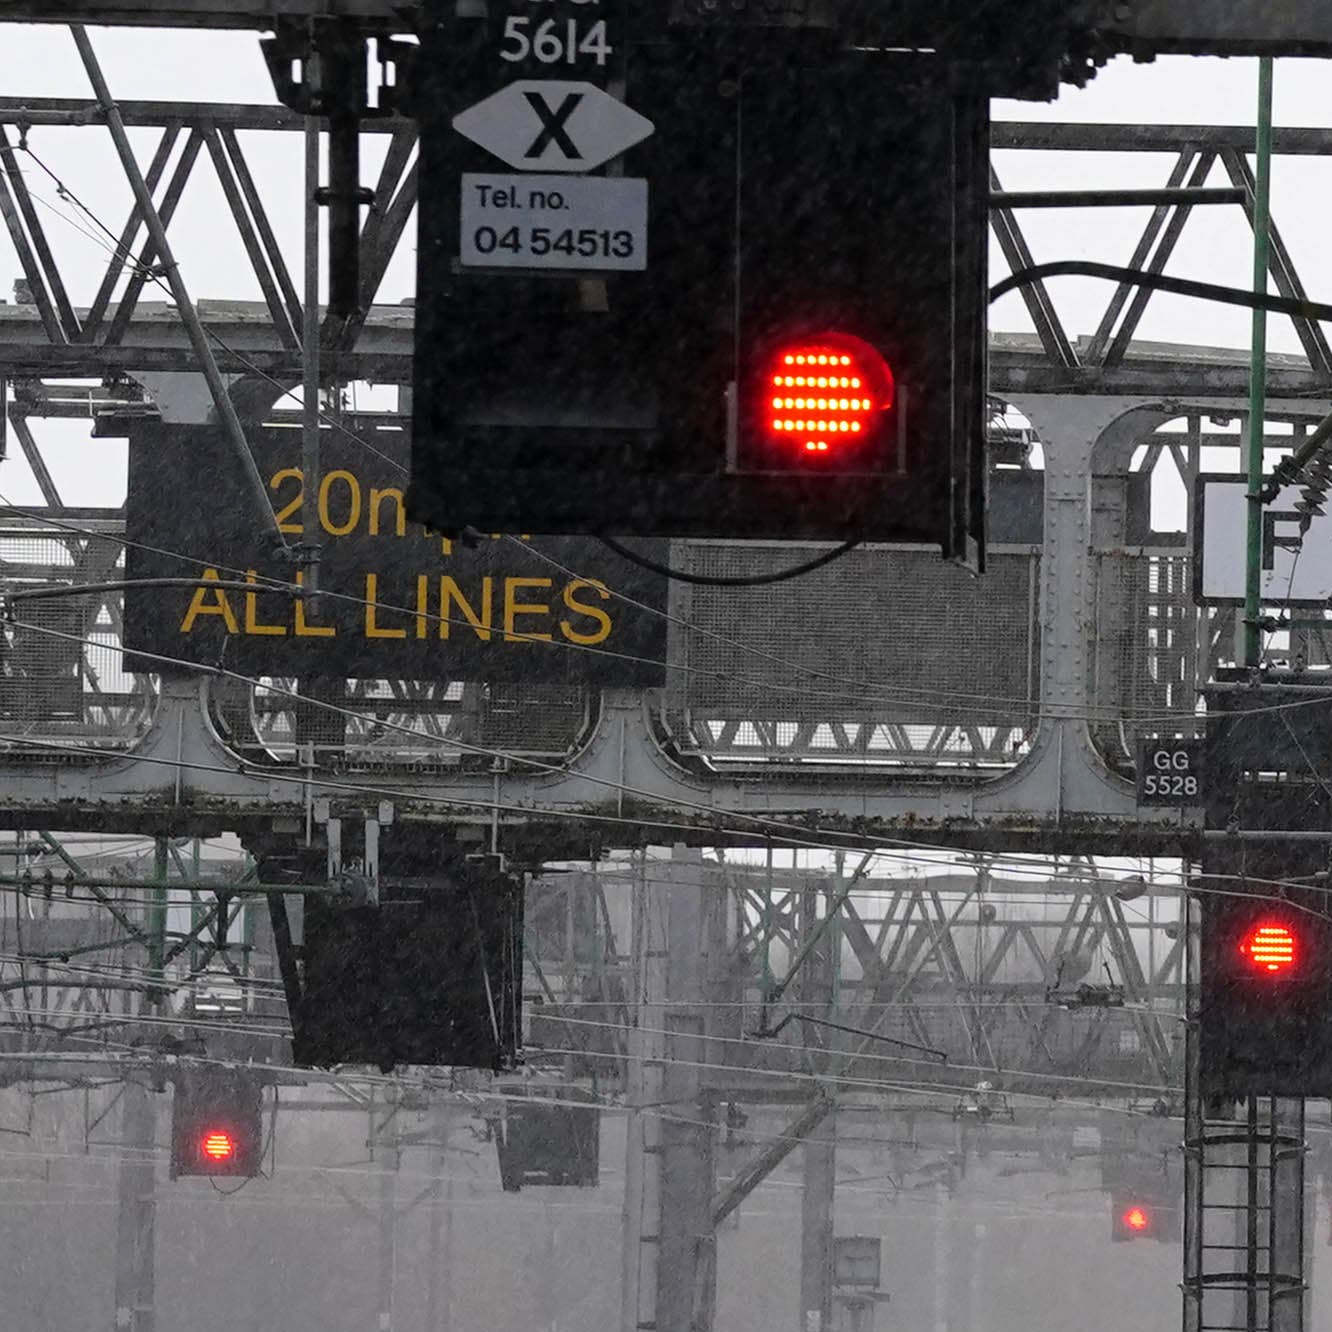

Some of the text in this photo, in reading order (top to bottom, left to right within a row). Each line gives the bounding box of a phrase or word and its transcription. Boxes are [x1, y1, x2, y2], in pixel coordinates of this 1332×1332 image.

[500, 16, 613, 65] 5614
[522, 91, 585, 160] X
[475, 185, 569, 210] Tel. no.
[474, 226, 634, 258] 04 54513
[1262, 511, 1303, 570] F
[180, 568, 614, 645] ALL LINES
[1153, 750, 1189, 770] GG
[1144, 775, 1197, 796] 5528
